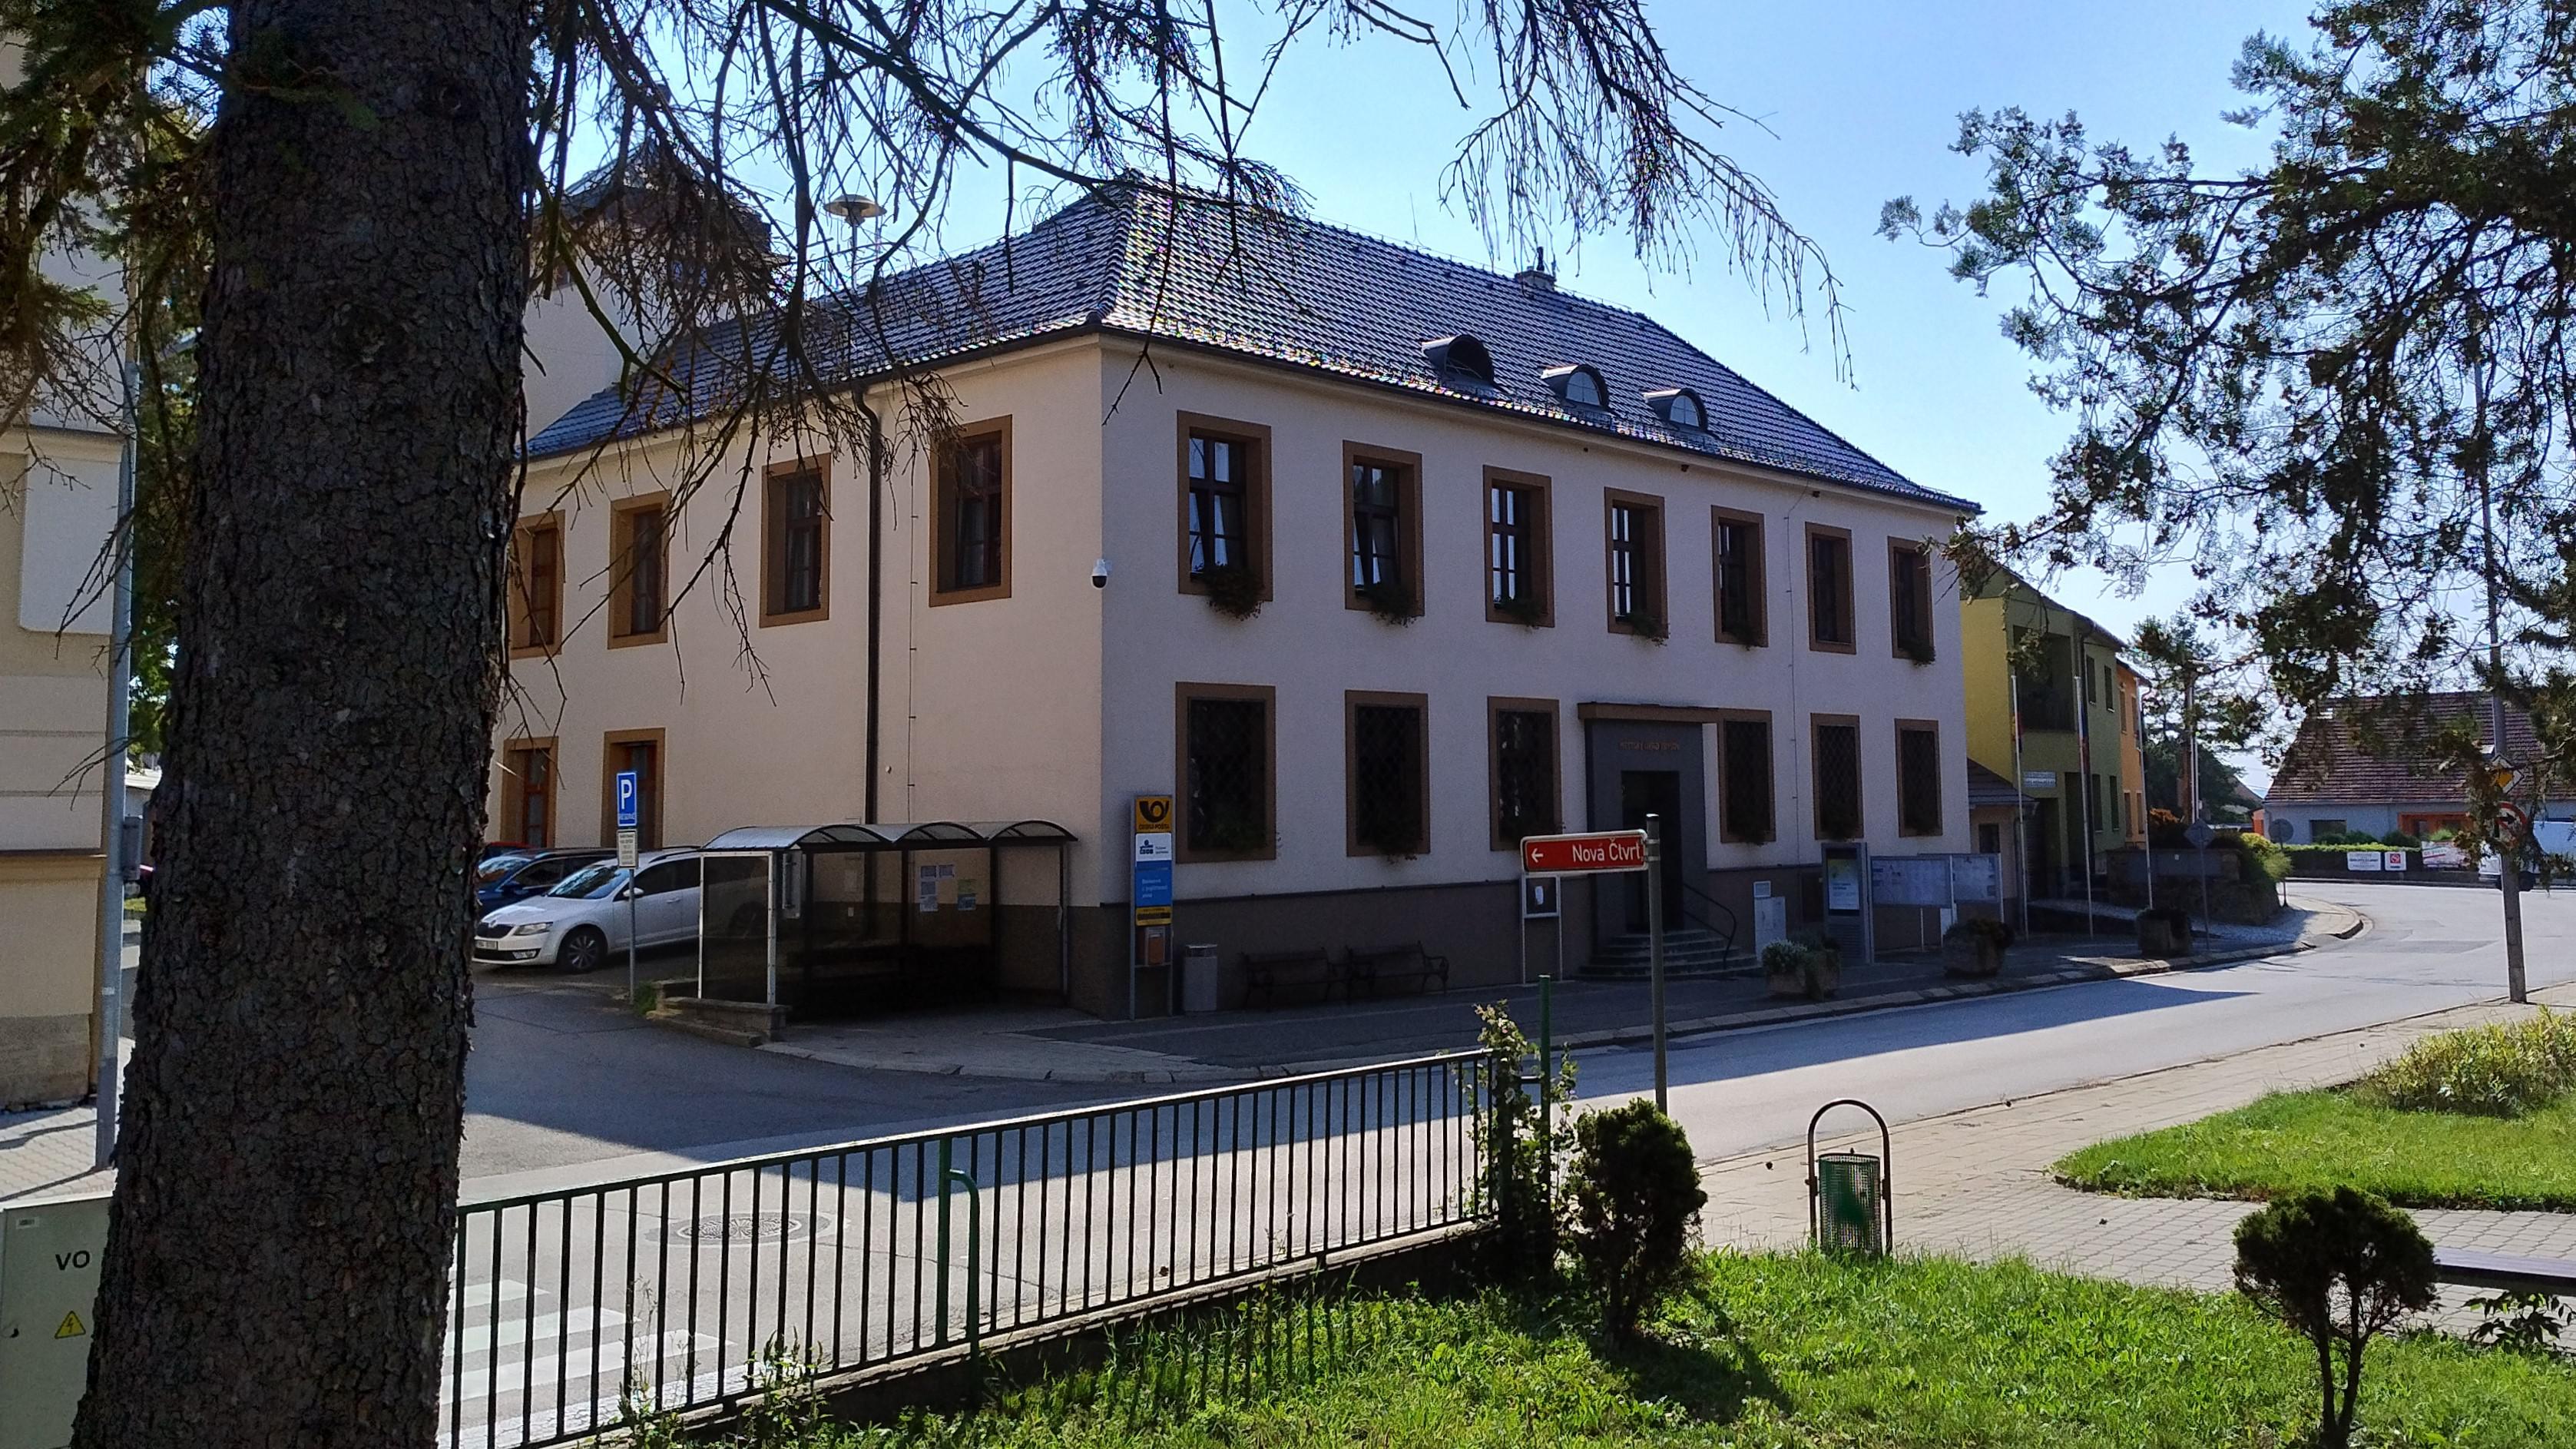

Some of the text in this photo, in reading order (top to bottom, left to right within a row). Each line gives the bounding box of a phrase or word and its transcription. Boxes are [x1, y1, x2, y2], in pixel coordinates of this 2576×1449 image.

[621, 779, 633, 810] P
[1572, 843, 1605, 862] Nová
[55, 1250, 90, 1271] VO
